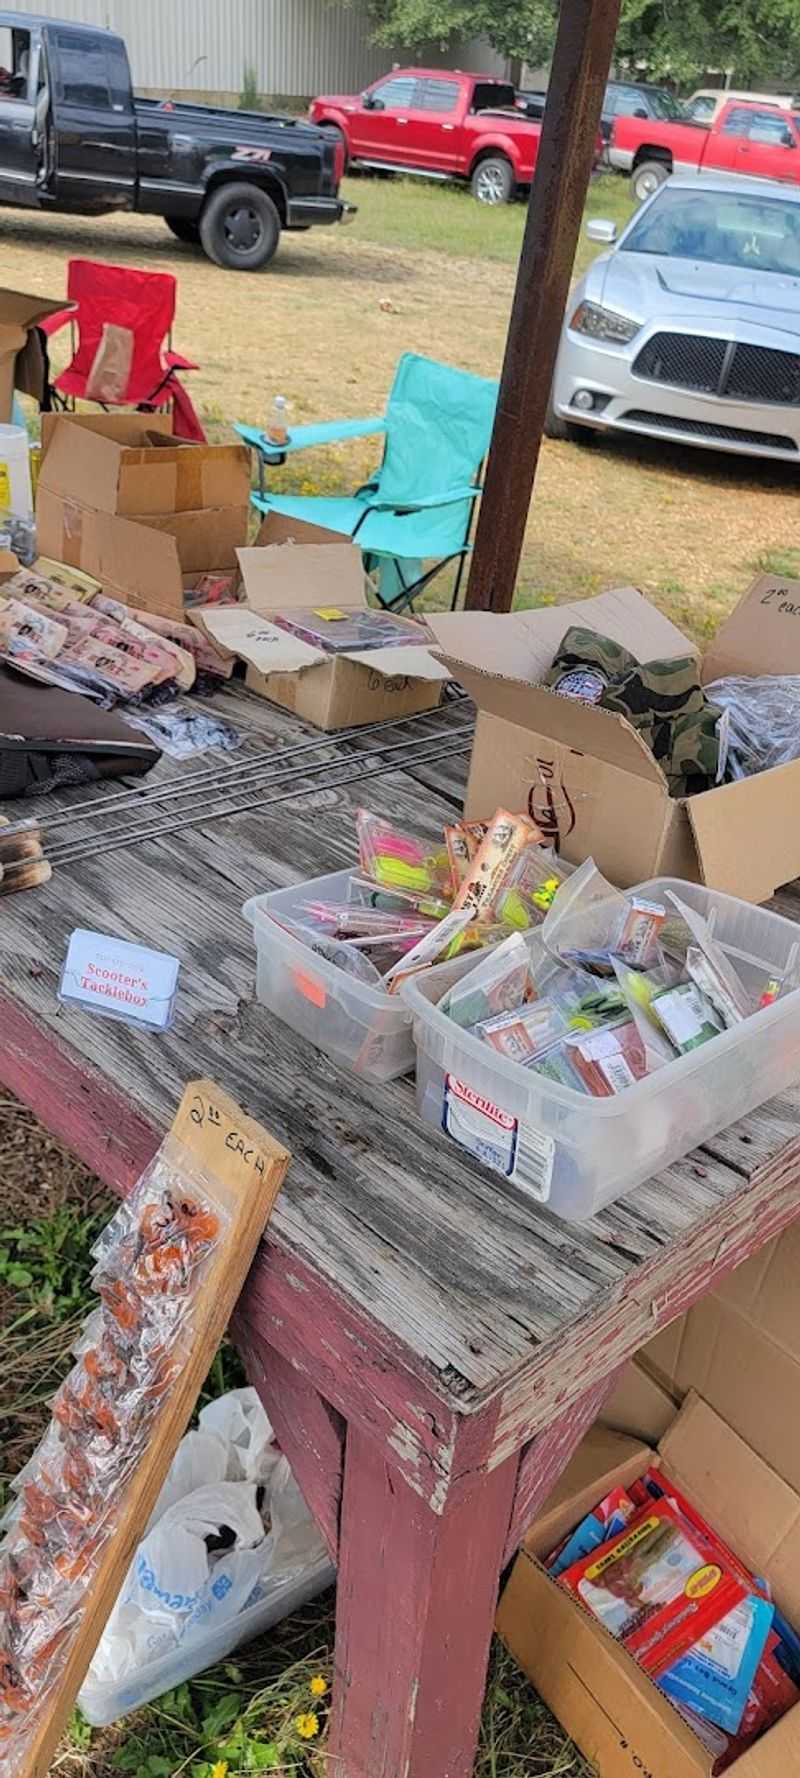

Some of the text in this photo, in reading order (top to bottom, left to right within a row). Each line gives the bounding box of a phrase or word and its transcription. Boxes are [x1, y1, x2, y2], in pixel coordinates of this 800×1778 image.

[231, 145, 273, 163] Z71
[80, 976, 148, 1008] Tacklebox
[86, 961, 149, 991] Scooter's
[454, 1079, 509, 1123] Sterilite
[224, 1131, 266, 1177] EACH
